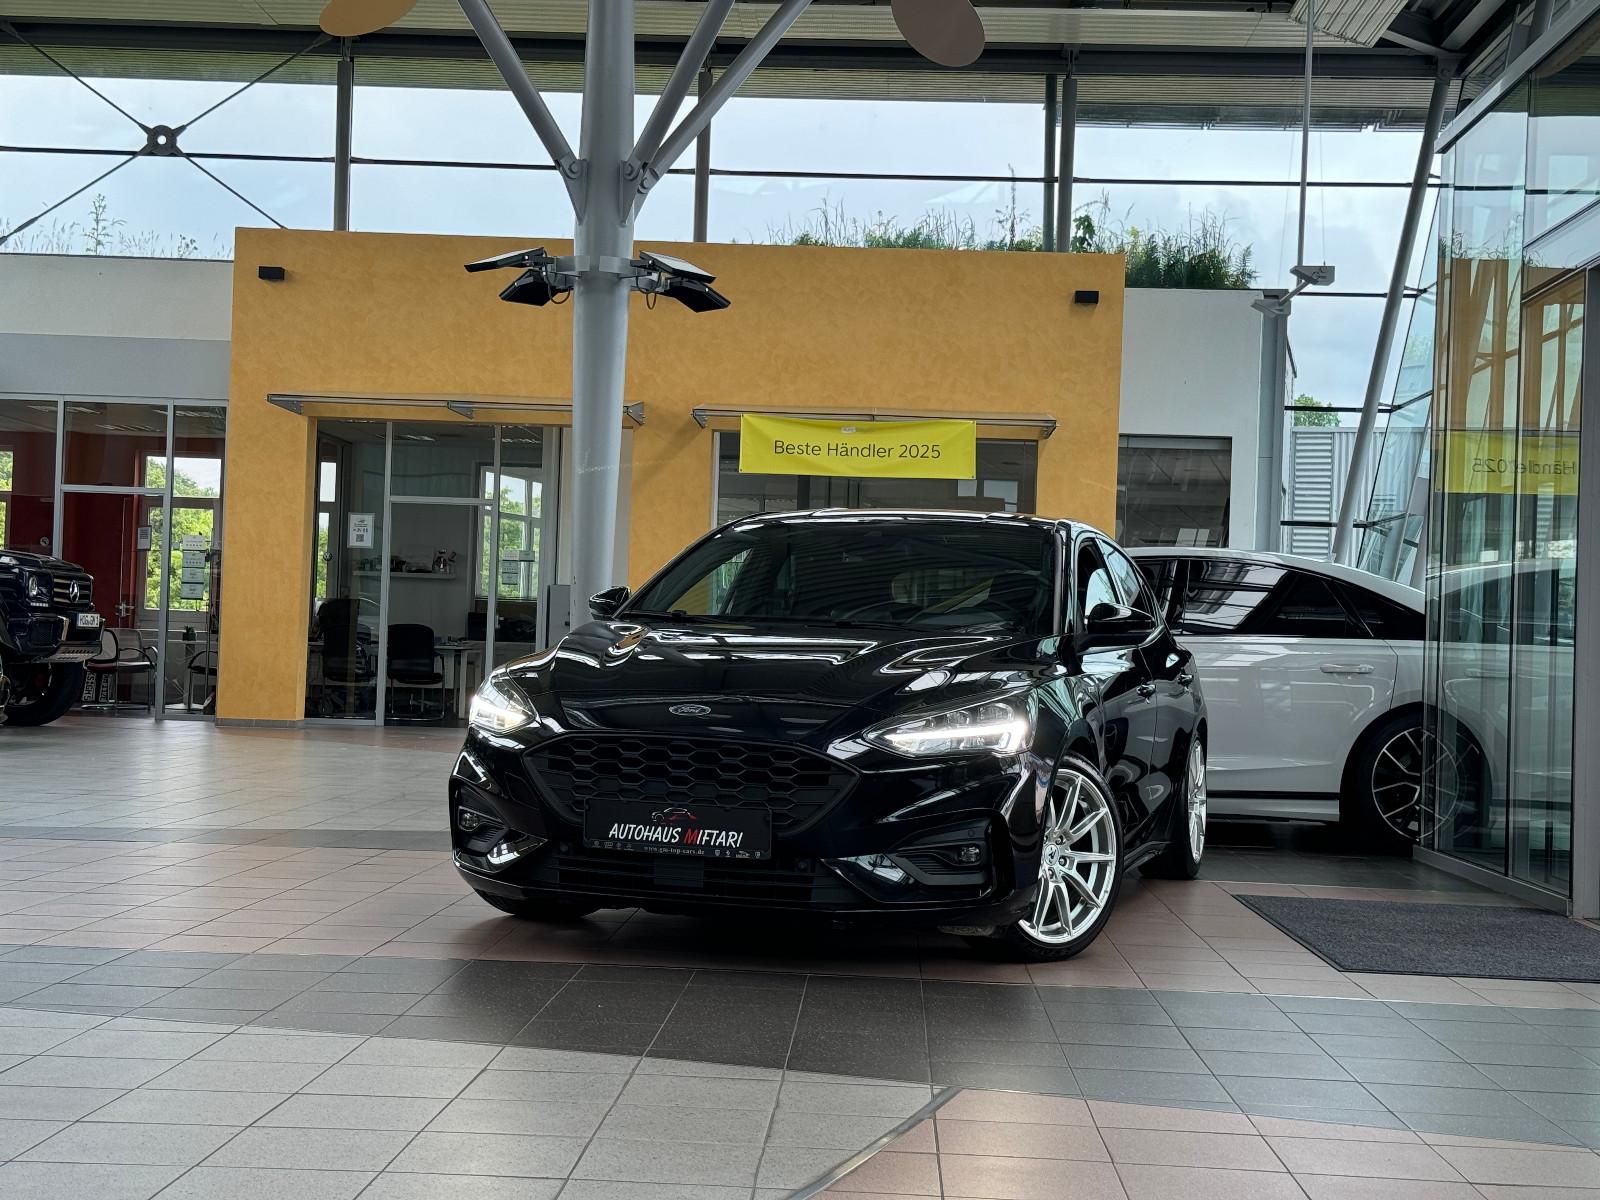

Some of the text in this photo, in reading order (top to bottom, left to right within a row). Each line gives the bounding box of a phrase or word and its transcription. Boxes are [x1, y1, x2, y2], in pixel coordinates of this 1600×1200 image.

[774, 440, 941, 459] Beste Händler 2025
[609, 823, 743, 848] AUTOHAUS MIFTARI
